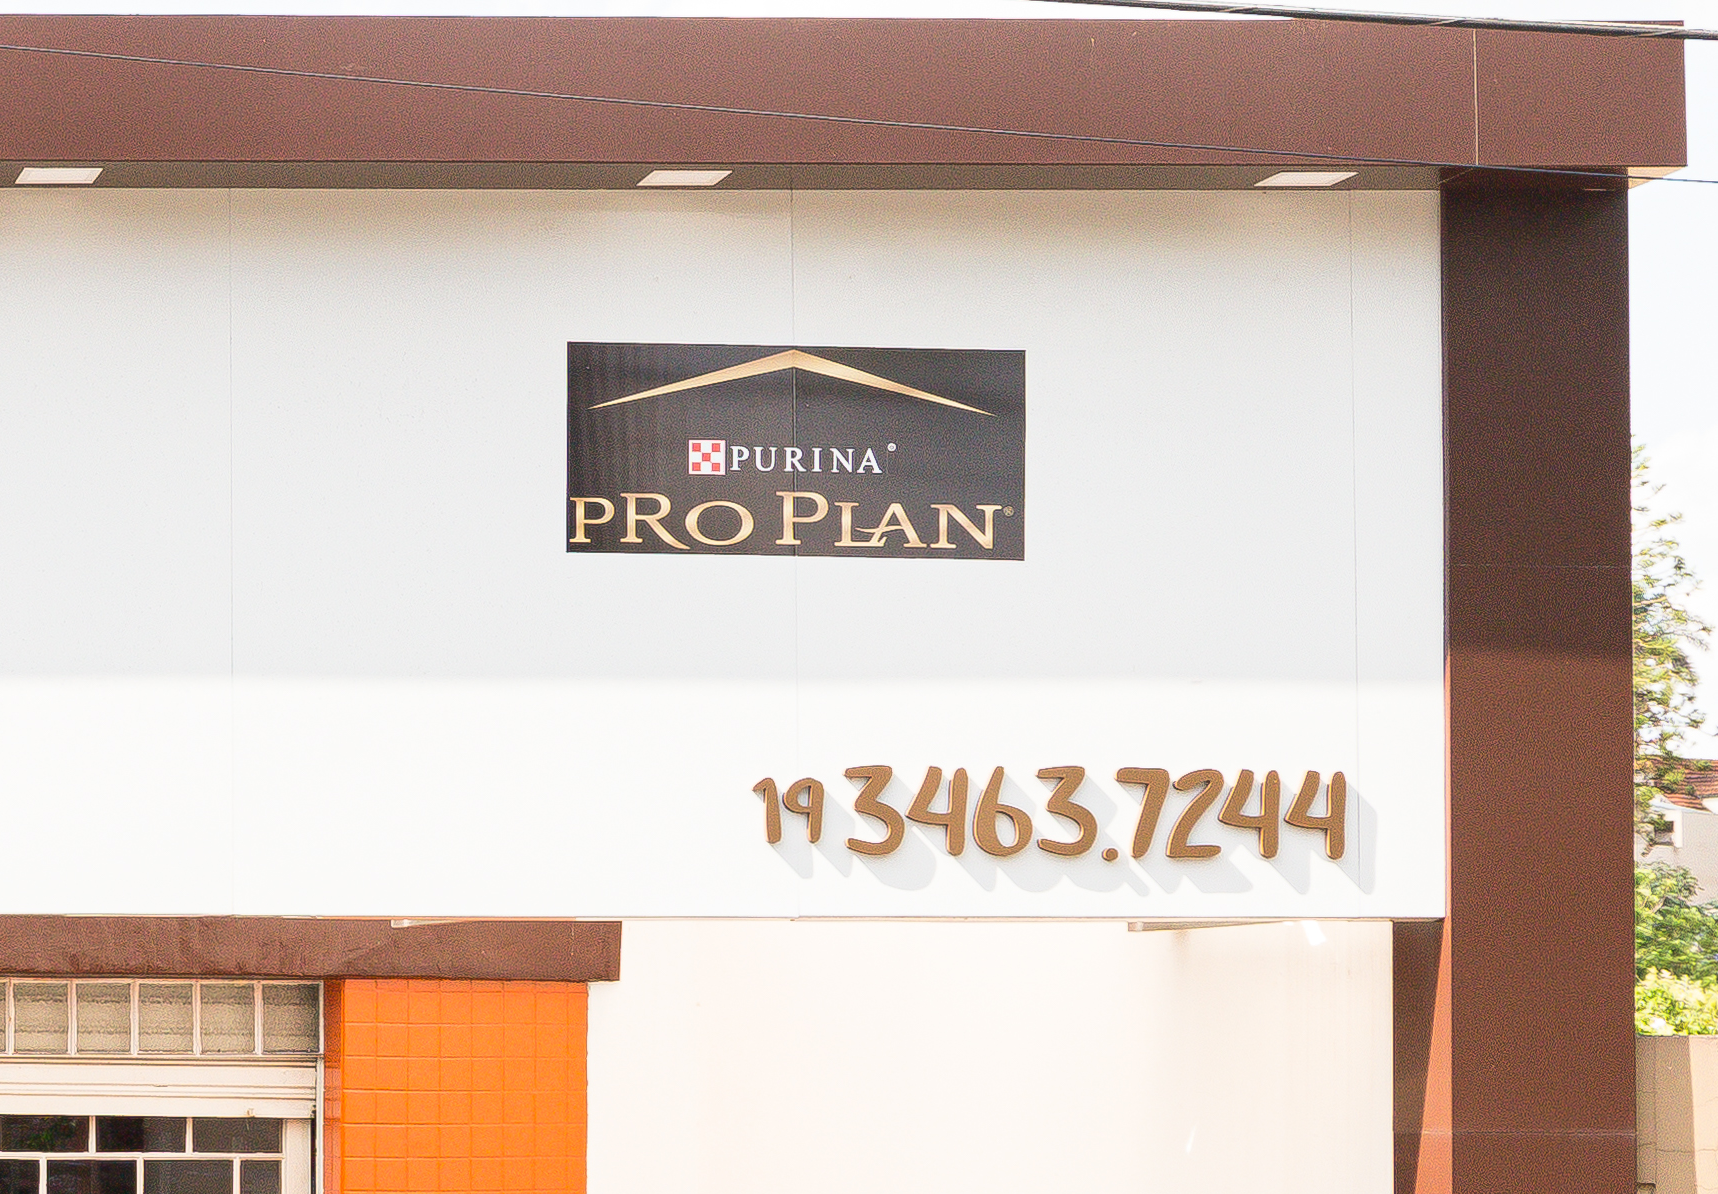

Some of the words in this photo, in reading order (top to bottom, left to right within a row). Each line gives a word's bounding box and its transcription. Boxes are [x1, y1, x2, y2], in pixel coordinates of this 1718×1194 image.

[730, 445, 883, 474] PURINA
[569, 492, 756, 550] PRO
[775, 490, 1003, 550] PLAN
[752, 777, 825, 845] 19
[843, 765, 1347, 862] 3463.7244
